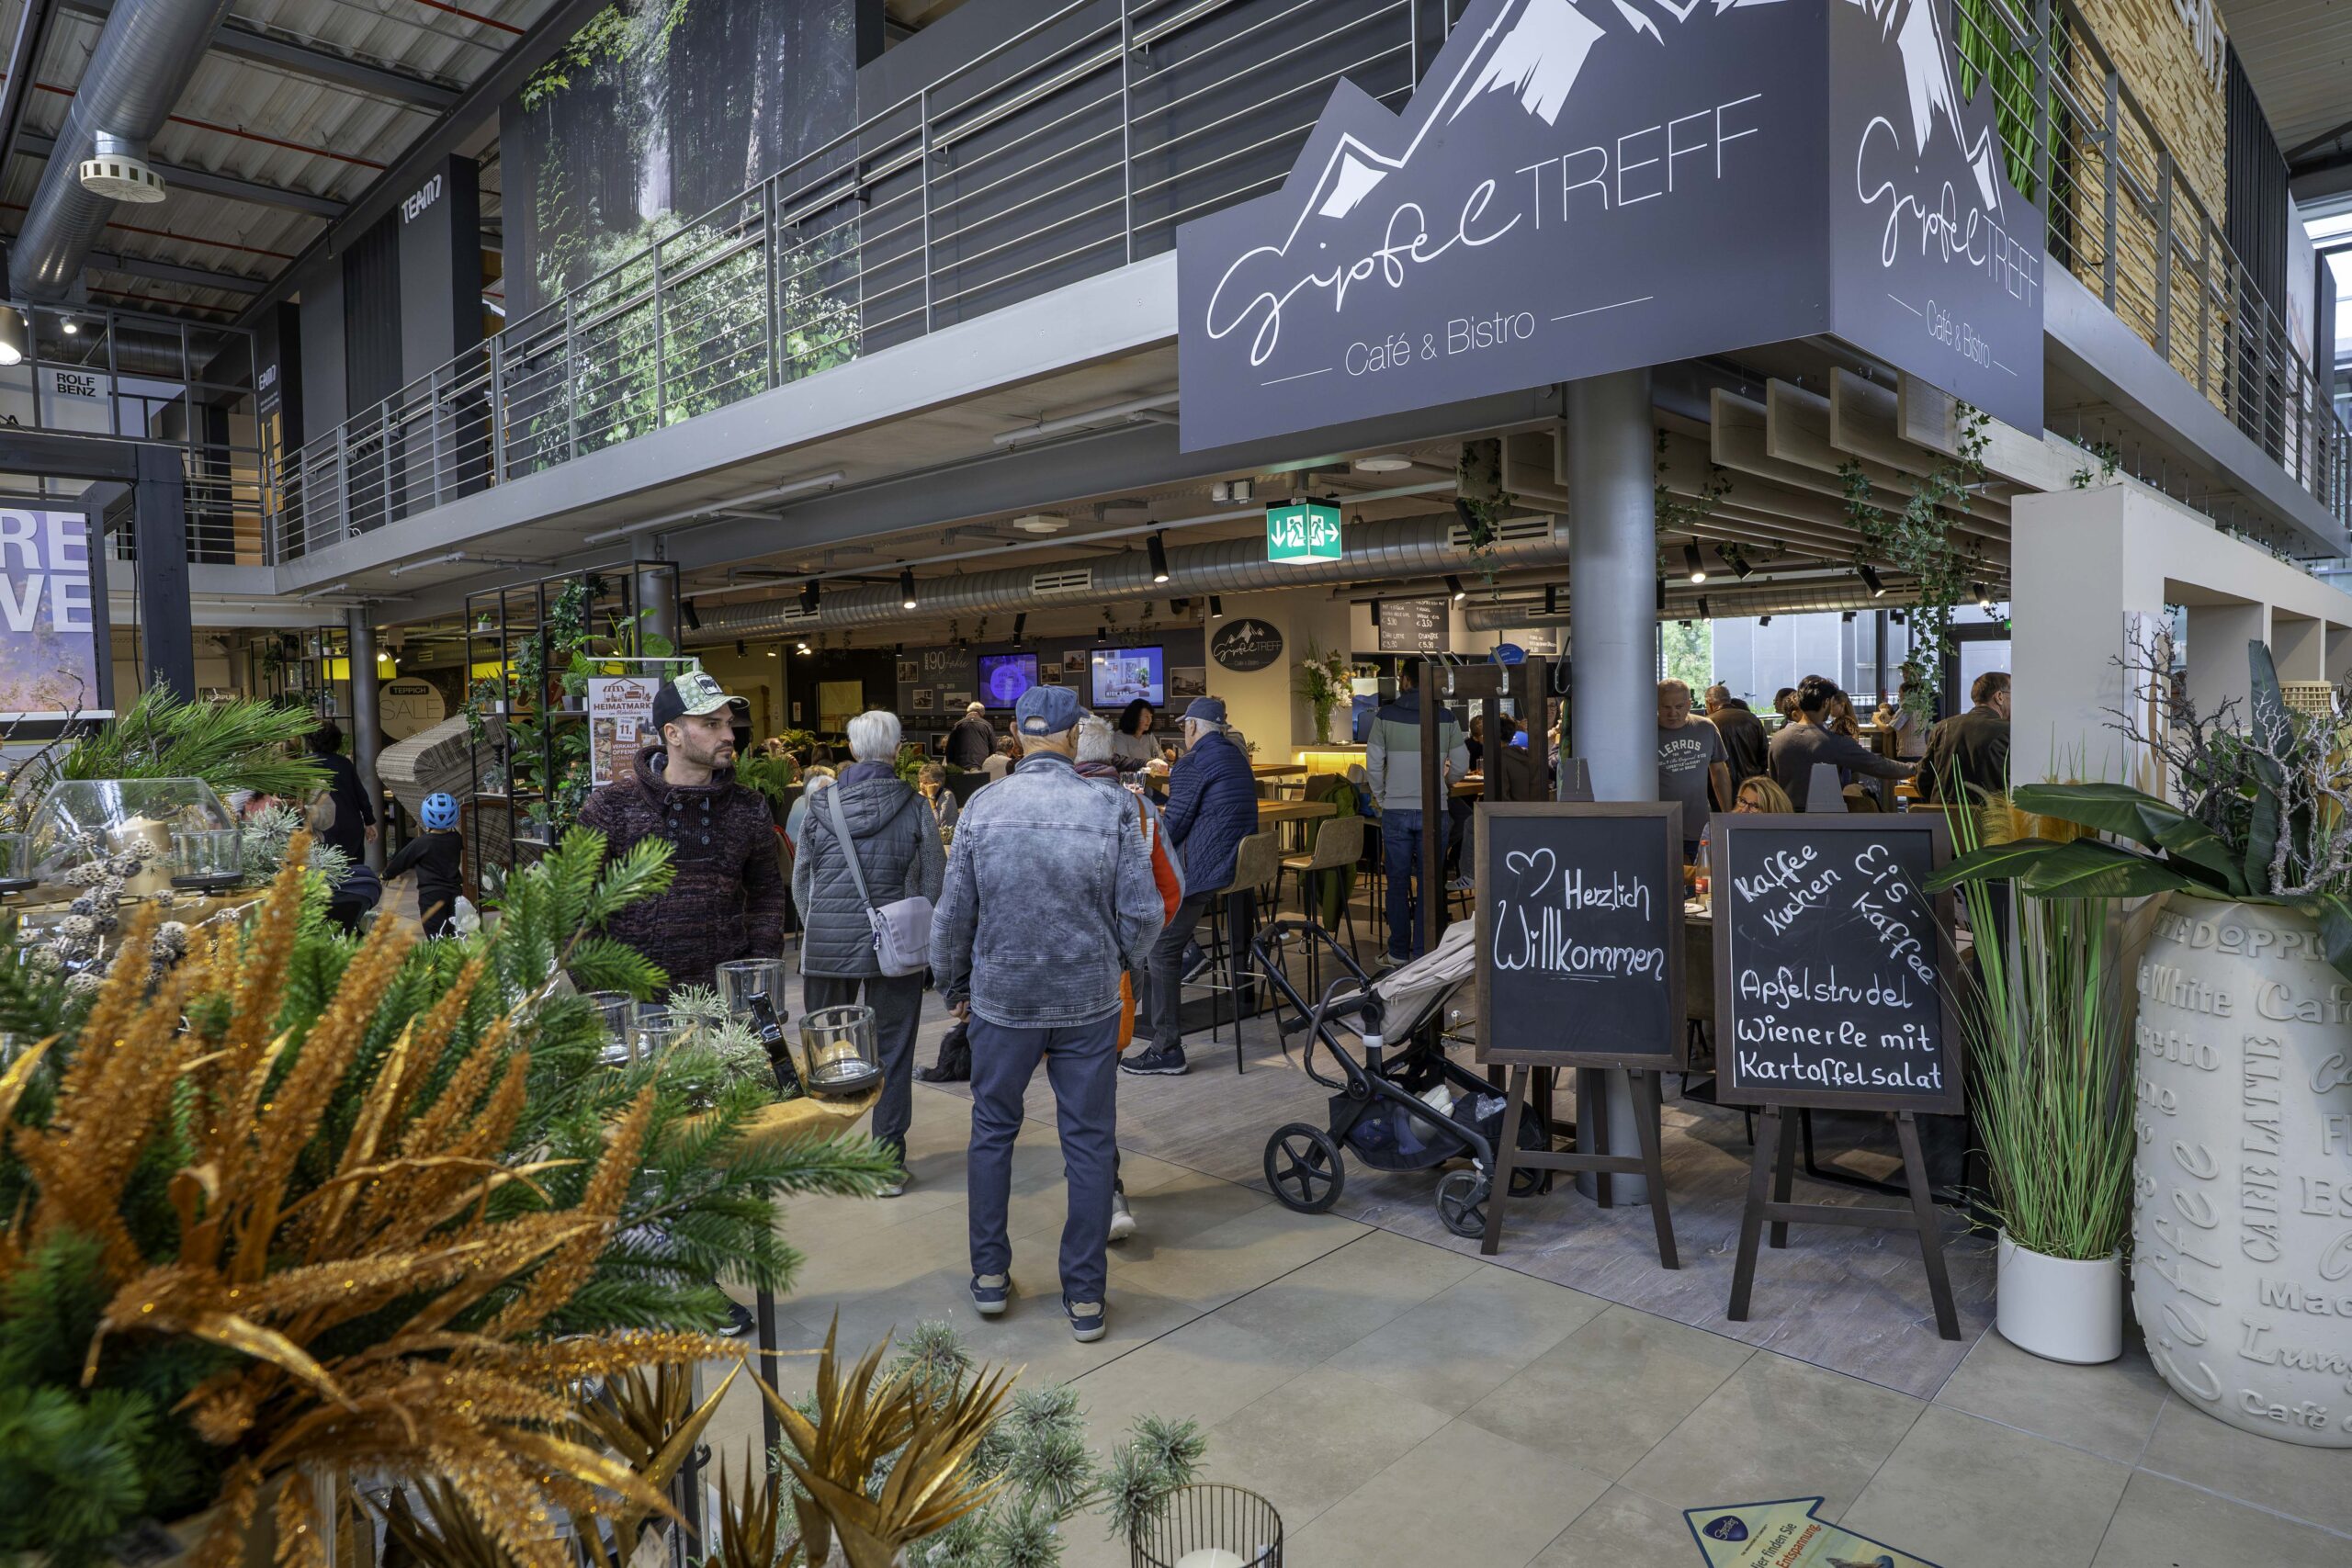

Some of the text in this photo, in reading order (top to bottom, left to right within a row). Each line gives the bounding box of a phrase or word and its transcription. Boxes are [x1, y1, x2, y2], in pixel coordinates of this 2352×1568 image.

[1345, 311, 1535, 376] Café & Bistro
[1927, 300, 1990, 368] Café & Bistro
[56, 372, 96, 387] ROLF
[57, 384, 96, 398] BENZ
[379, 699, 442, 721] SALE
[619, 724, 633, 735] 11.
[1658, 739, 1702, 758] LERROS
[1565, 868, 1649, 921] Herzlich
[1735, 844, 1817, 903] Kaffee
[1763, 869, 1841, 936] Kuchen
[1494, 900, 1664, 981] Willkommen
[1852, 892, 1935, 986] Kaffee
[1740, 965, 1913, 1010] Apfelstrudel
[2152, 964, 2234, 1018] White
[1737, 1015, 1935, 1052] Wienerle mit
[1739, 1050, 1941, 1089] Kartoffelsalat
[2243, 1033, 2282, 1156] LATTE
[1760, 1532, 1791, 1559] finden
[1779, 1521, 1799, 1537] Sie
[1774, 1522, 1823, 1568] Entspannung.
